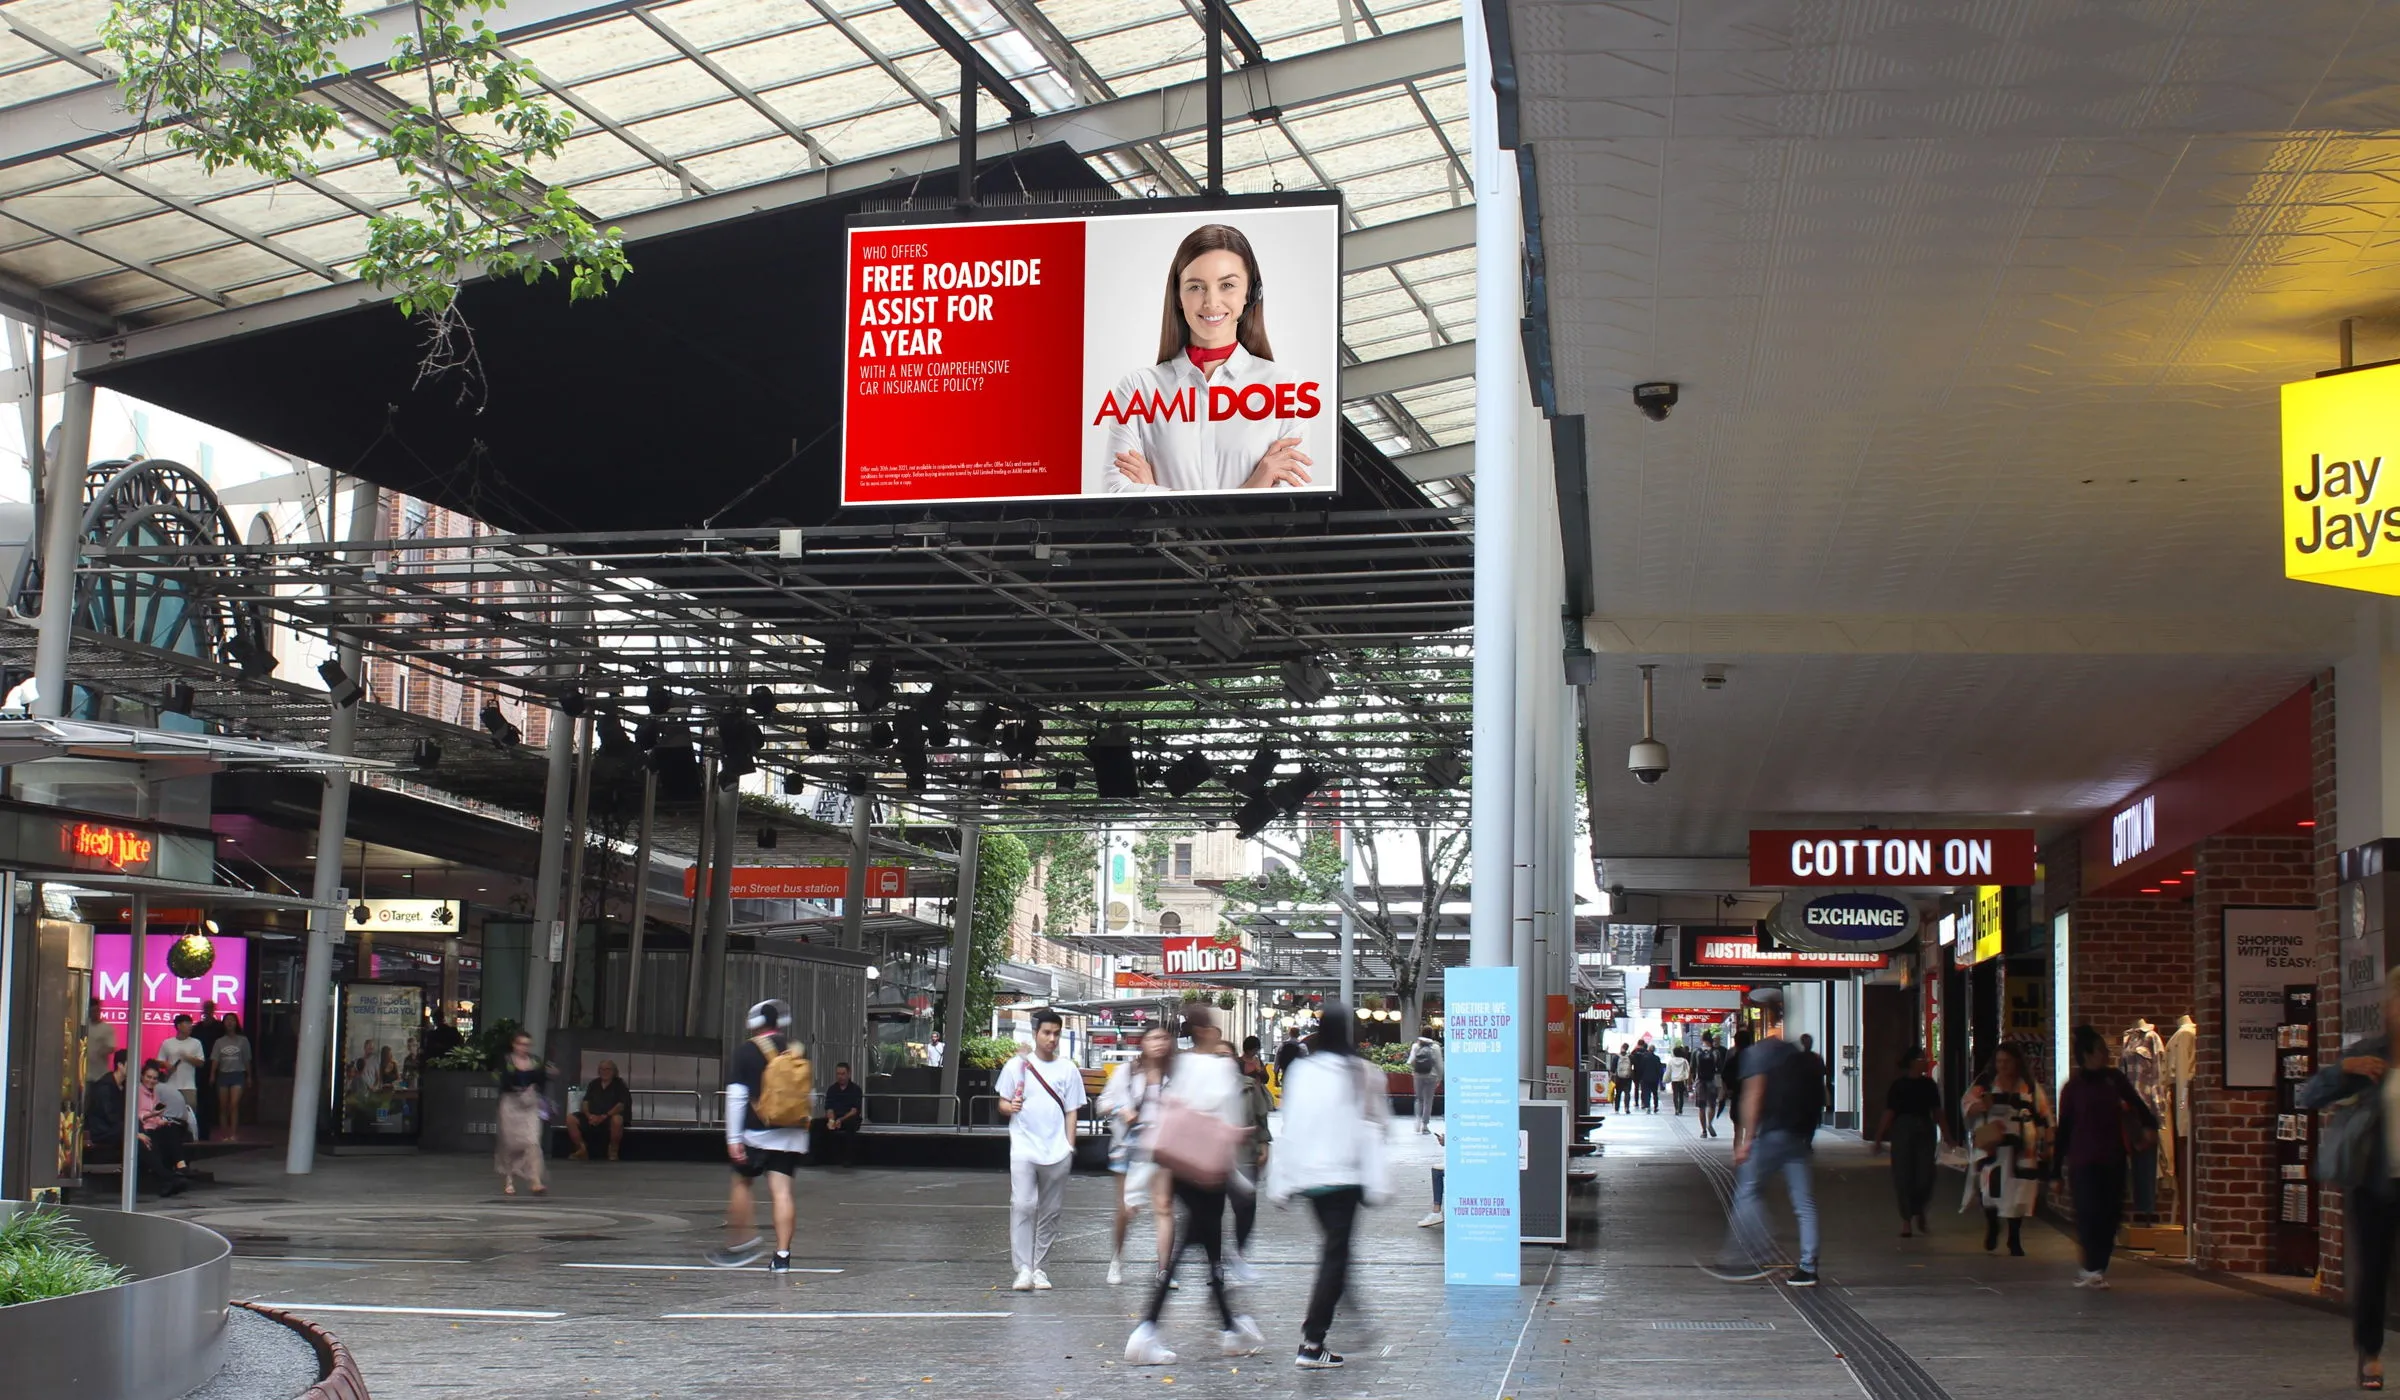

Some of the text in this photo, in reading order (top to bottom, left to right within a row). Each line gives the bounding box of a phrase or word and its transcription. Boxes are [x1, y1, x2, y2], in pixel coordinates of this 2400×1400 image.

[863, 244, 928, 260] WHO OFFERS
[862, 258, 1041, 293] FREE ROADSIDE
[859, 294, 994, 326] ASSIST FOR
[858, 328, 943, 358] A YEAR
[860, 359, 1010, 379] WITH A NEW COMPREHENSIVE
[860, 376, 984, 396] CAR INSURANCE POLICY?
[1093, 381, 1322, 426] AAMI DOES
[2294, 453, 2382, 505] Jay
[2295, 505, 2400, 559] Jays
[79, 823, 114, 855] fresh
[2113, 795, 2155, 867] COTTON ON
[1791, 839, 1992, 876] COTTON ON
[749, 884, 782, 893] Street
[783, 884, 802, 893] bus
[804, 884, 840, 893] station
[1807, 907, 1904, 927] EXCHANGE
[2237, 936, 2303, 946] SHOPPING
[1166, 938, 1237, 973] milano
[2238, 947, 2289, 957] WITH US
[2266, 958, 2316, 968] IS EASY:
[100, 971, 239, 1005] MYER
[1450, 1002, 1507, 1014] TOGETHER WE
[1451, 1015, 1511, 1026] CAN HELP STOP
[1451, 1029, 1498, 1039] THE SPREAD
[1454, 1207, 1511, 1216] YOUR COOPERATION
[1459, 1197, 1504, 1206] THANK YOU FOR
